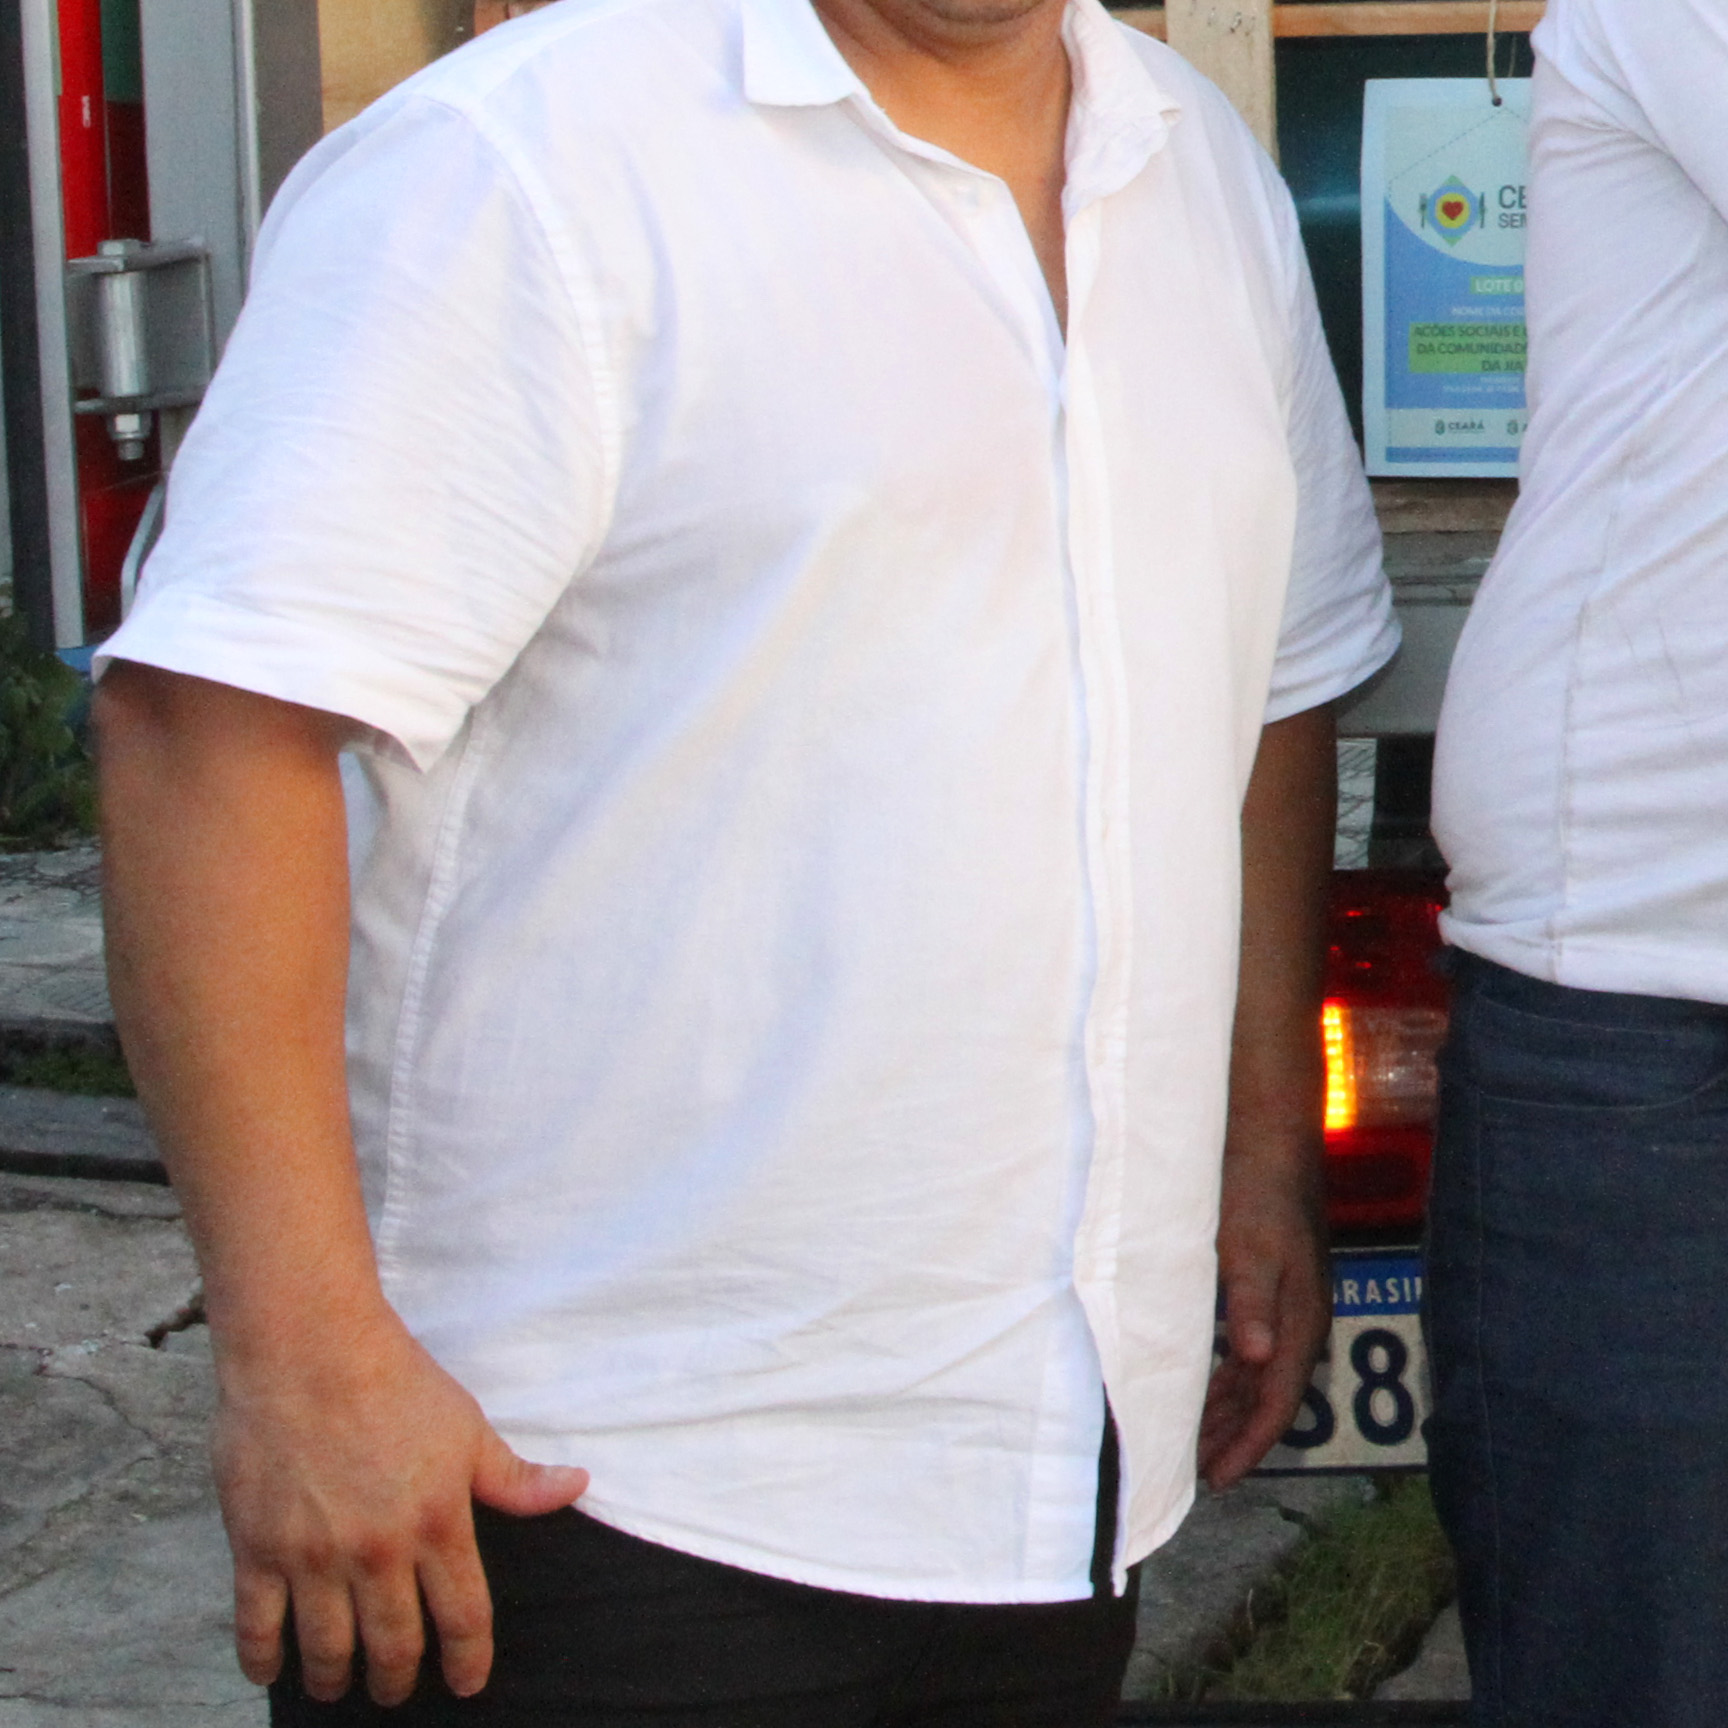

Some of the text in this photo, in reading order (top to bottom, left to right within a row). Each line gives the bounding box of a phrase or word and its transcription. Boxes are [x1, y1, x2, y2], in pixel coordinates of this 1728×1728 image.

[1475, 279, 1511, 292] LOTE
[1459, 325, 1510, 337] SOCIAIS
[1417, 343, 1436, 354] DA
[1481, 360, 1501, 372] DA
[1448, 419, 1485, 430] CEARÁ
